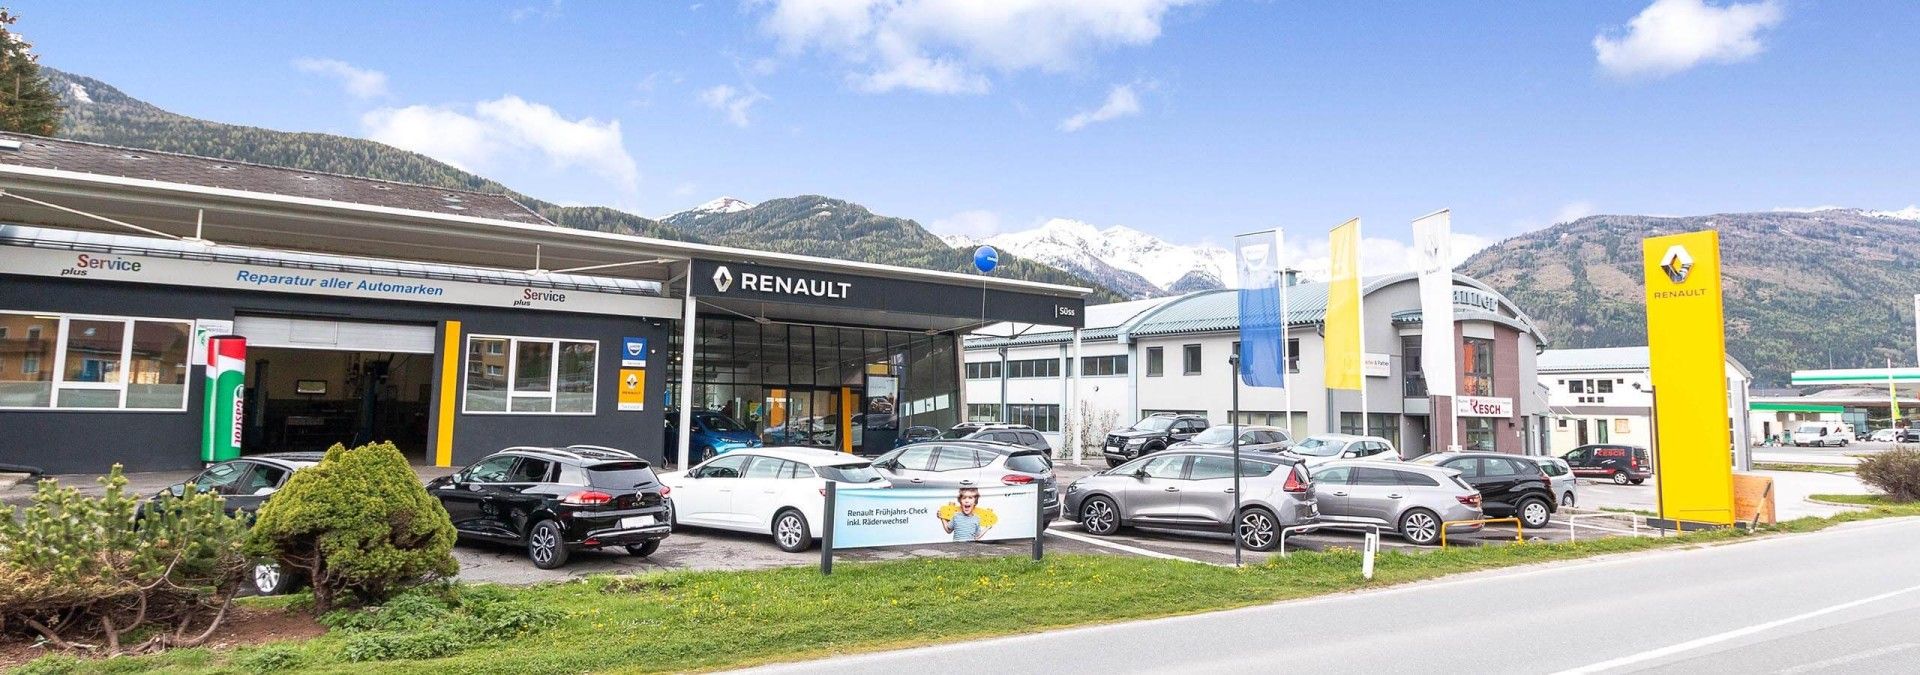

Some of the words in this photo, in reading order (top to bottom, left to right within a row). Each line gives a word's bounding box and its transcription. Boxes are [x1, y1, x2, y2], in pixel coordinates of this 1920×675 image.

[77, 253, 142, 272] Service
[61, 267, 87, 276] plus
[236, 270, 316, 287] Reparatur
[320, 277, 353, 290] aller
[356, 279, 444, 296] Automarken
[741, 272, 852, 299] RENAULT
[523, 288, 566, 302] Service
[1452, 289, 1498, 312] anner
[1654, 288, 1707, 299] RENAULT
[1470, 399, 1501, 415] RESCH
[847, 509, 874, 517] Renault
[875, 507, 928, 517] Frühjahrs-Check
[847, 518, 861, 526] inkl.
[862, 517, 909, 526] Räderwechsel
